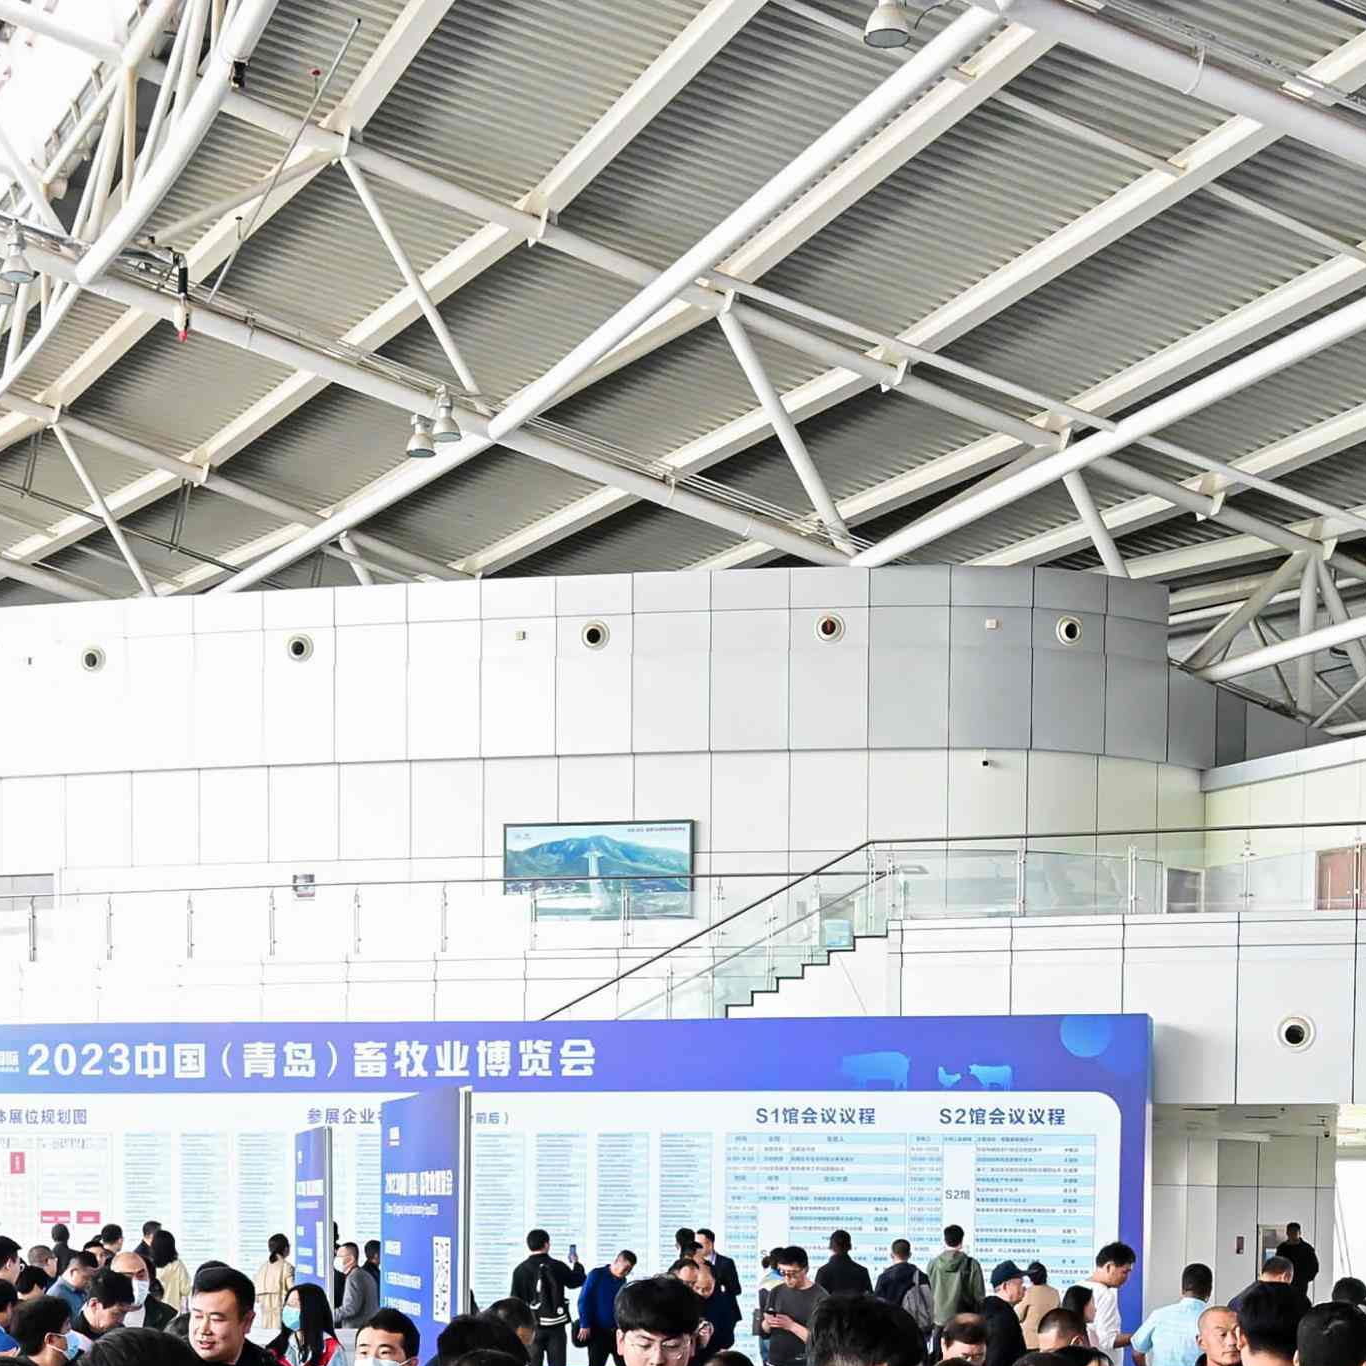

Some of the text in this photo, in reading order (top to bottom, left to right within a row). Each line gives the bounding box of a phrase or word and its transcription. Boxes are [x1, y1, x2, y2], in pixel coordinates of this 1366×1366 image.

[27, 1041, 596, 1079] 2023中国（青岛）畜牧业博览会
[307, 1108, 509, 1126] 参展企业 前后）
[755, 1106, 876, 1125] S1馆会议议程
[939, 1107, 1066, 1125] S2馆会议议程
